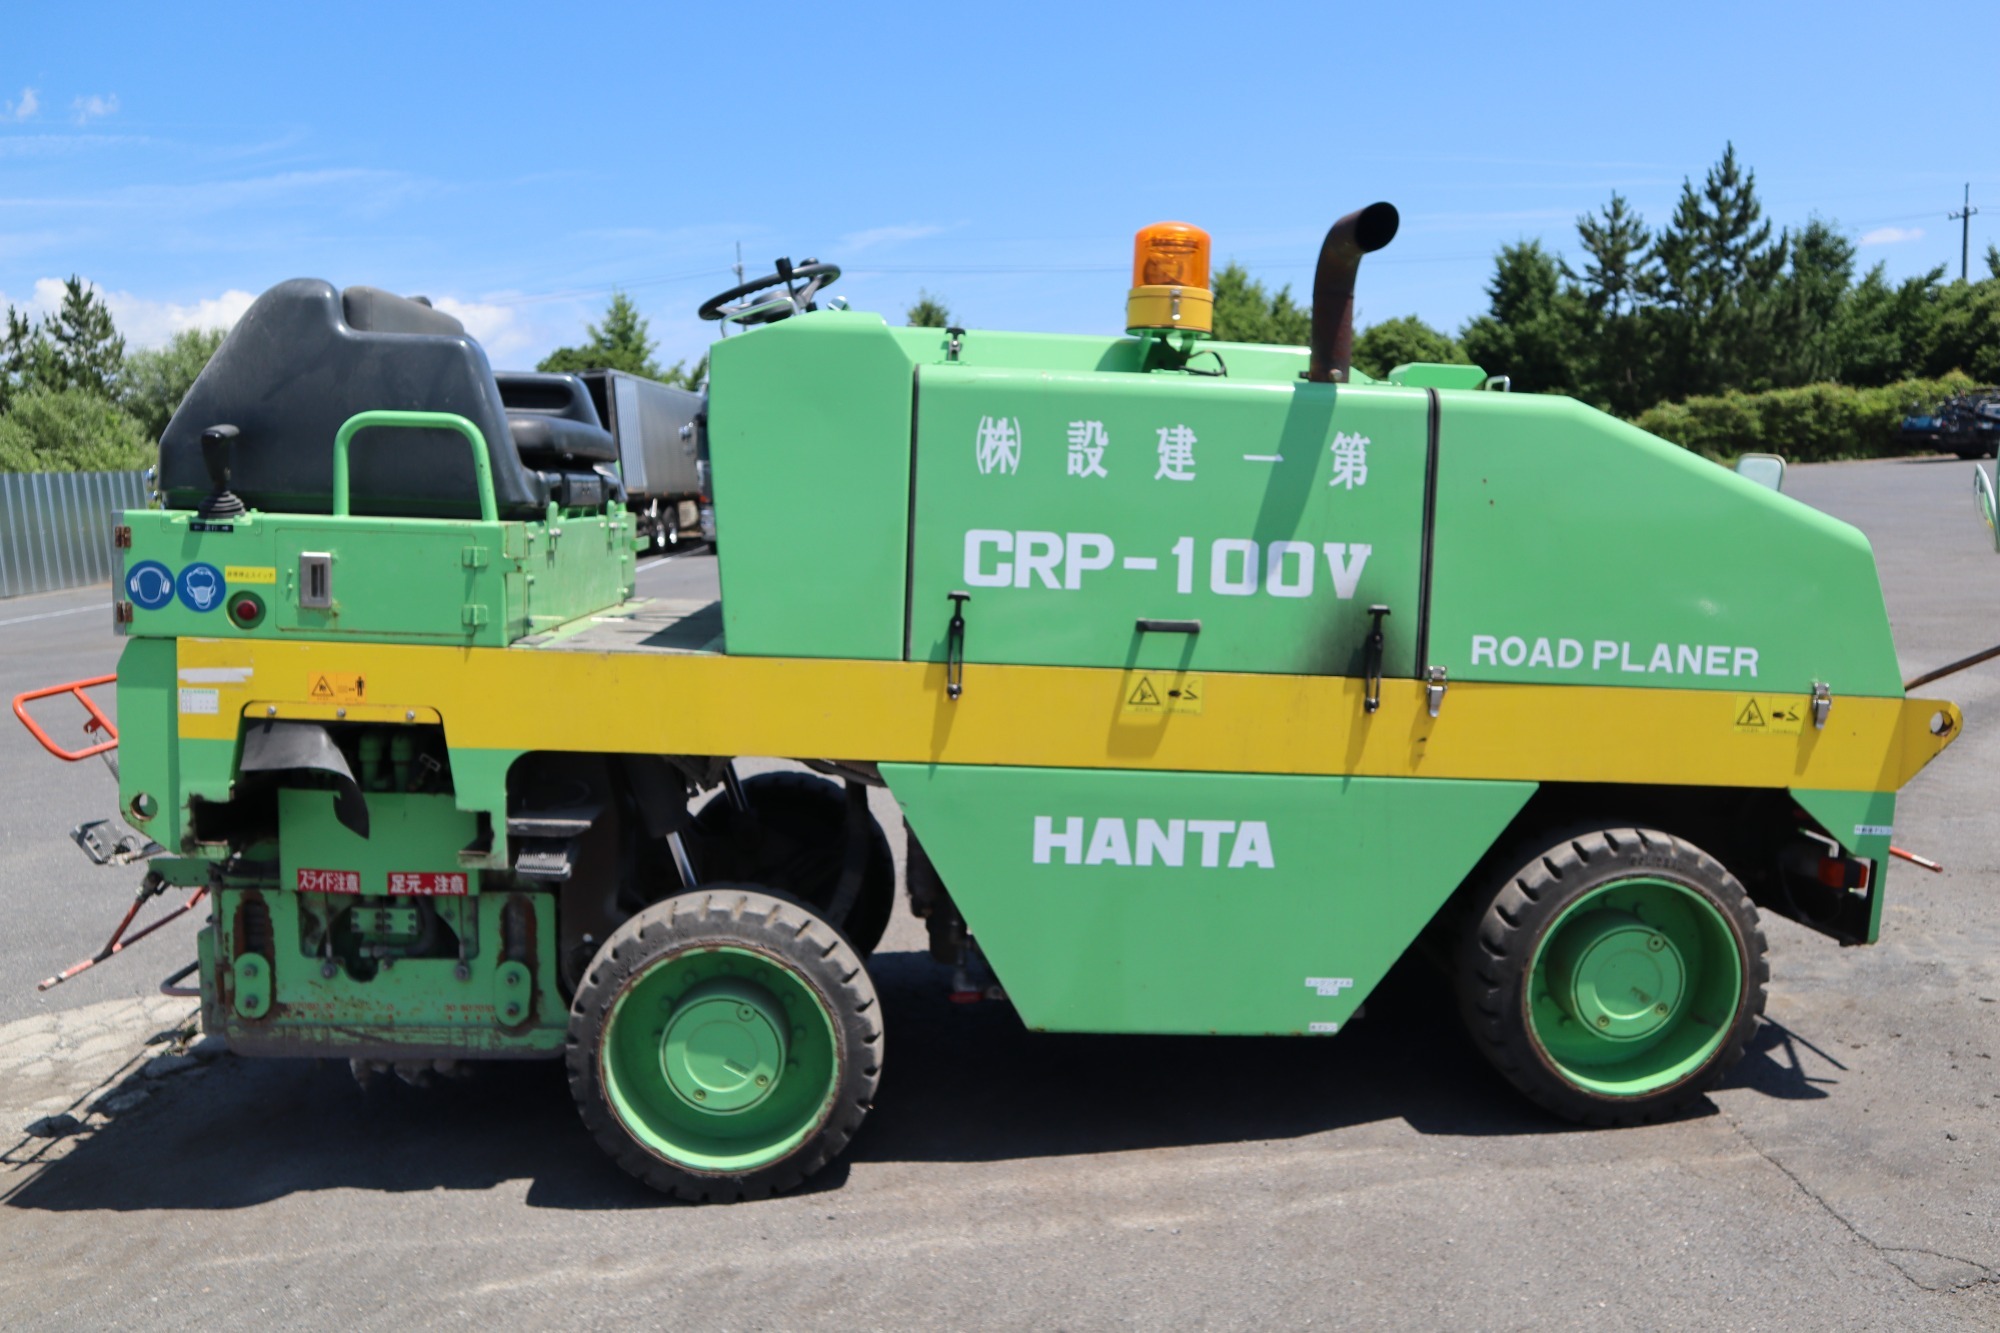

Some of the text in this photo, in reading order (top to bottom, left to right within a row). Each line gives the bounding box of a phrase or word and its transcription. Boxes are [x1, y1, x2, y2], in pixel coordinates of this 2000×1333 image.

[963, 529, 1372, 598] CRP-100V
[1471, 634, 1759, 677] ROAD PLANER
[1033, 816, 1275, 869] HANTA
